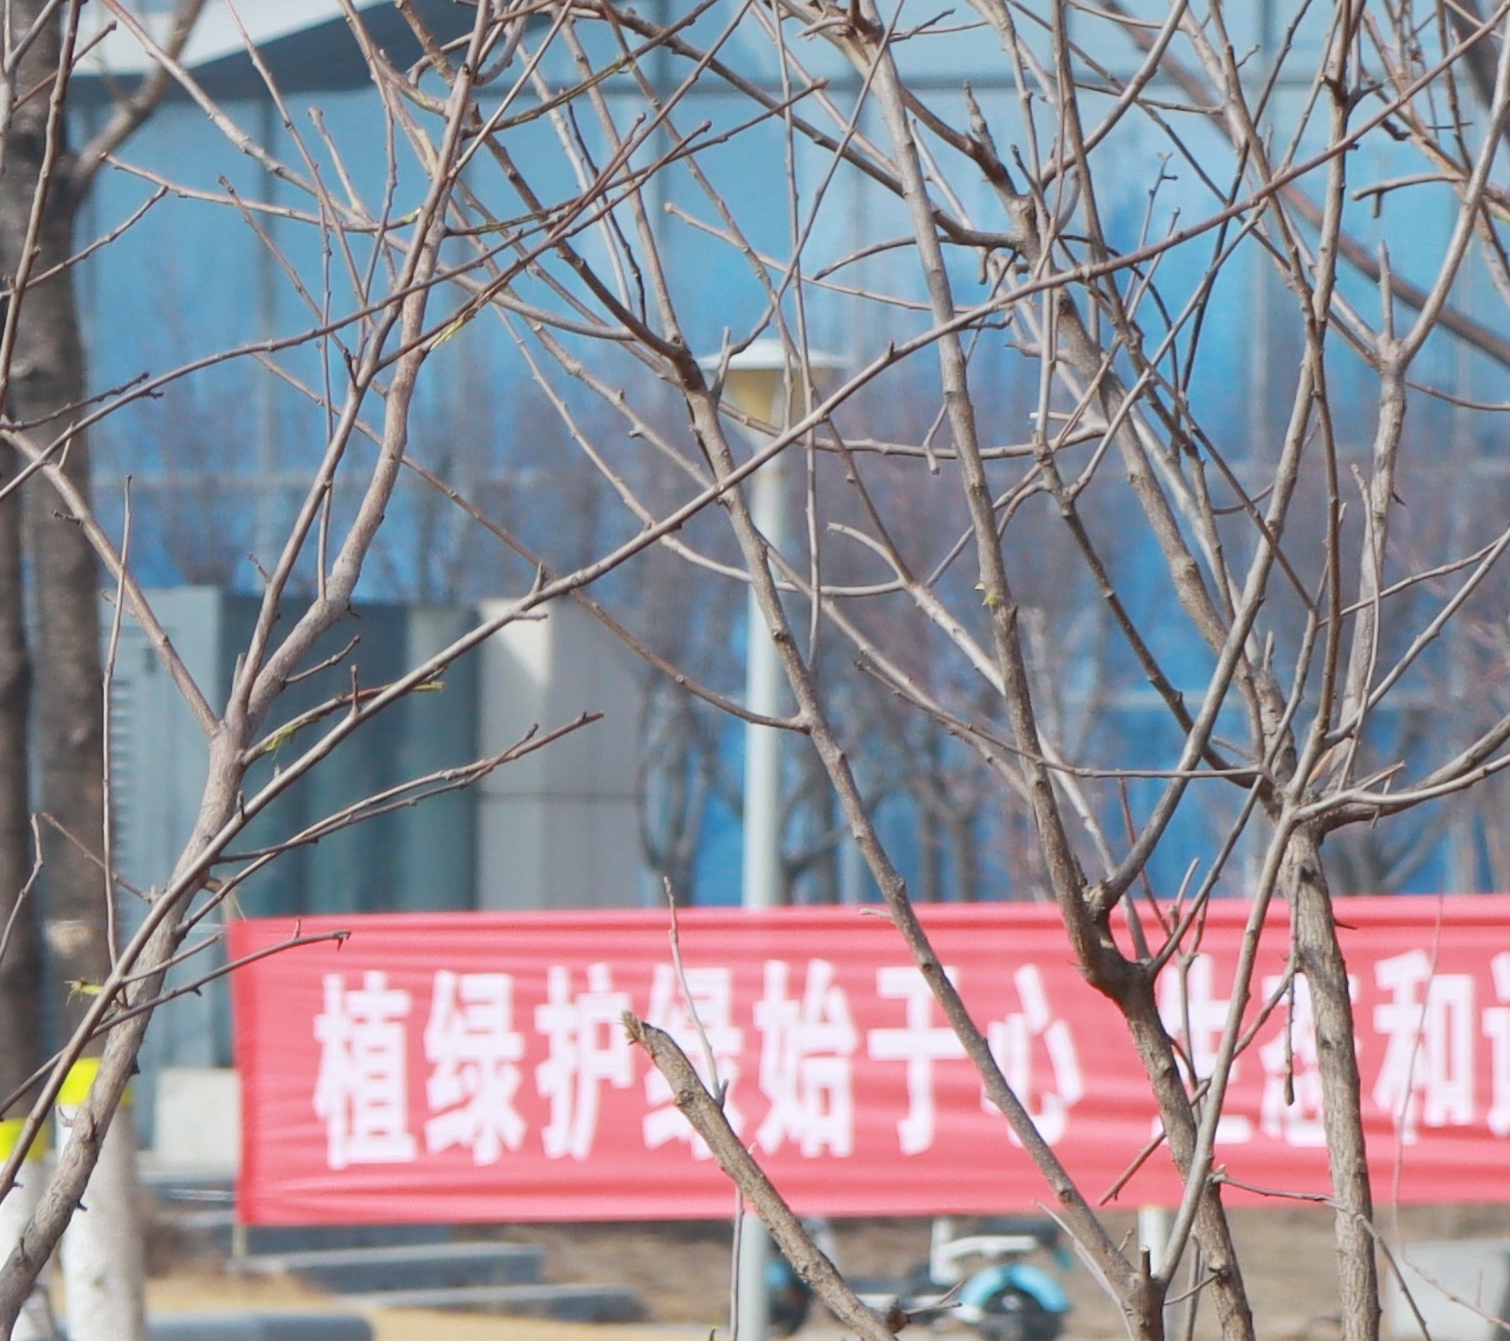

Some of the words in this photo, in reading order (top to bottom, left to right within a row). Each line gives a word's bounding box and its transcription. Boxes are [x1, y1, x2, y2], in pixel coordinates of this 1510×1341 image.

[313, 959, 1083, 1169] 植绿护绿始于心
